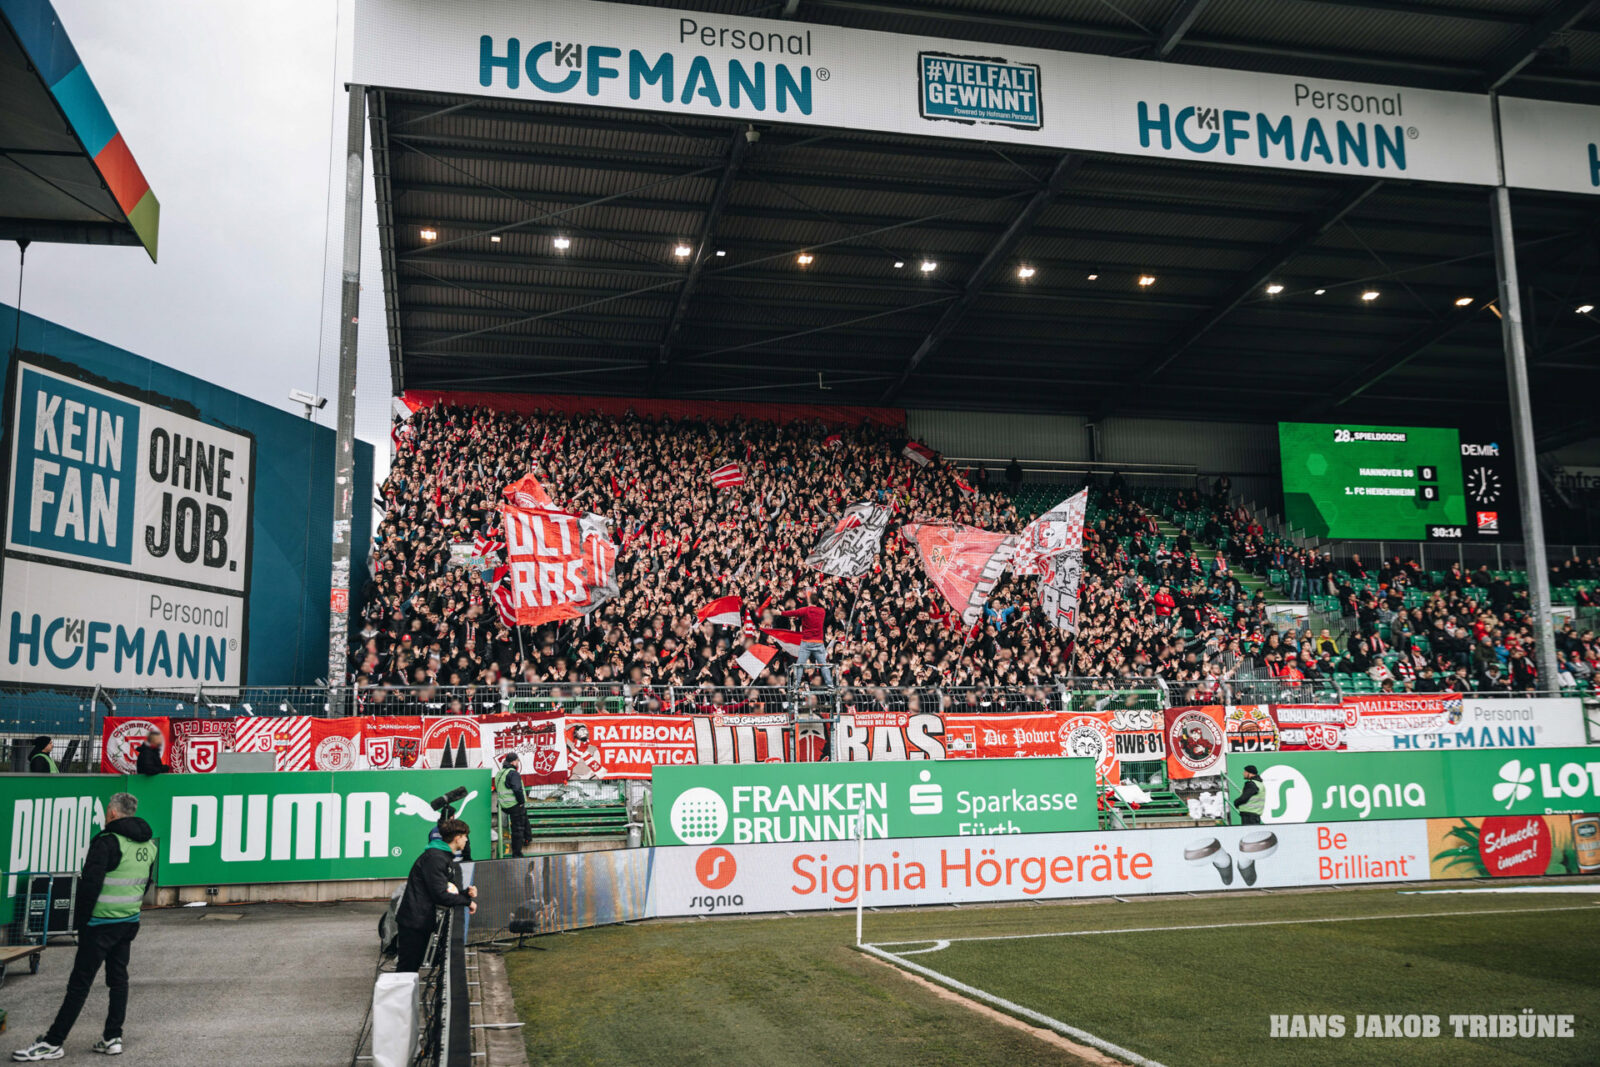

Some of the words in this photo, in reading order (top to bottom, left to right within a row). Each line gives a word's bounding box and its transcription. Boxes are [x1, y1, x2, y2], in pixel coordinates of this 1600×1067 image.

[680, 18, 811, 56] Personal
[926, 60, 1033, 90] #VIELFALT
[928, 82, 1033, 112] GEWINNT
[1295, 83, 1402, 116] Personal
[954, 107, 978, 116] Powered
[986, 109, 1011, 119] Hofmann
[1011, 112, 1034, 121] Personal
[34, 390, 124, 472] KEIN
[149, 427, 234, 501] OHNE
[1359, 468, 1402, 477] HANNOVER
[1423, 468, 1432, 479] 0
[29, 457, 120, 548] FAN
[1345, 487, 1353, 495] 1.
[1354, 487, 1365, 495] FC
[1366, 488, 1416, 496] HEIDENHEIM
[1425, 487, 1434, 499] 0
[145, 492, 237, 572] JOB.
[1432, 527, 1462, 538] 30:14
[511, 558, 588, 608] RAS
[150, 594, 229, 629] Personal
[1110, 710, 1154, 731] JGS
[1360, 700, 1440, 712] MALLERSDORF
[1474, 706, 1533, 721] Personal
[174, 721, 200, 736] RED
[202, 720, 237, 736] BOYS
[594, 725, 694, 742] RATISBONA
[983, 728, 1008, 746] Die
[1013, 728, 1056, 748] Power
[1363, 716, 1443, 730] PFAFFENBERG
[604, 749, 696, 764] FANATICA
[732, 782, 888, 812] FRANKEN
[956, 789, 1078, 818] Sparkasse
[1322, 782, 1426, 818] signia
[169, 792, 390, 864] PUMA
[733, 813, 888, 844] BRUNNEN
[1317, 826, 1347, 850] Be
[1484, 820, 1540, 853] Schmeckt
[7, 796, 93, 898] PUMA
[136, 847, 149, 862] 68
[1498, 840, 1538, 870] immer!
[791, 851, 926, 903] Signia
[940, 844, 1153, 895] Hörgeräte
[689, 893, 744, 912] signia
